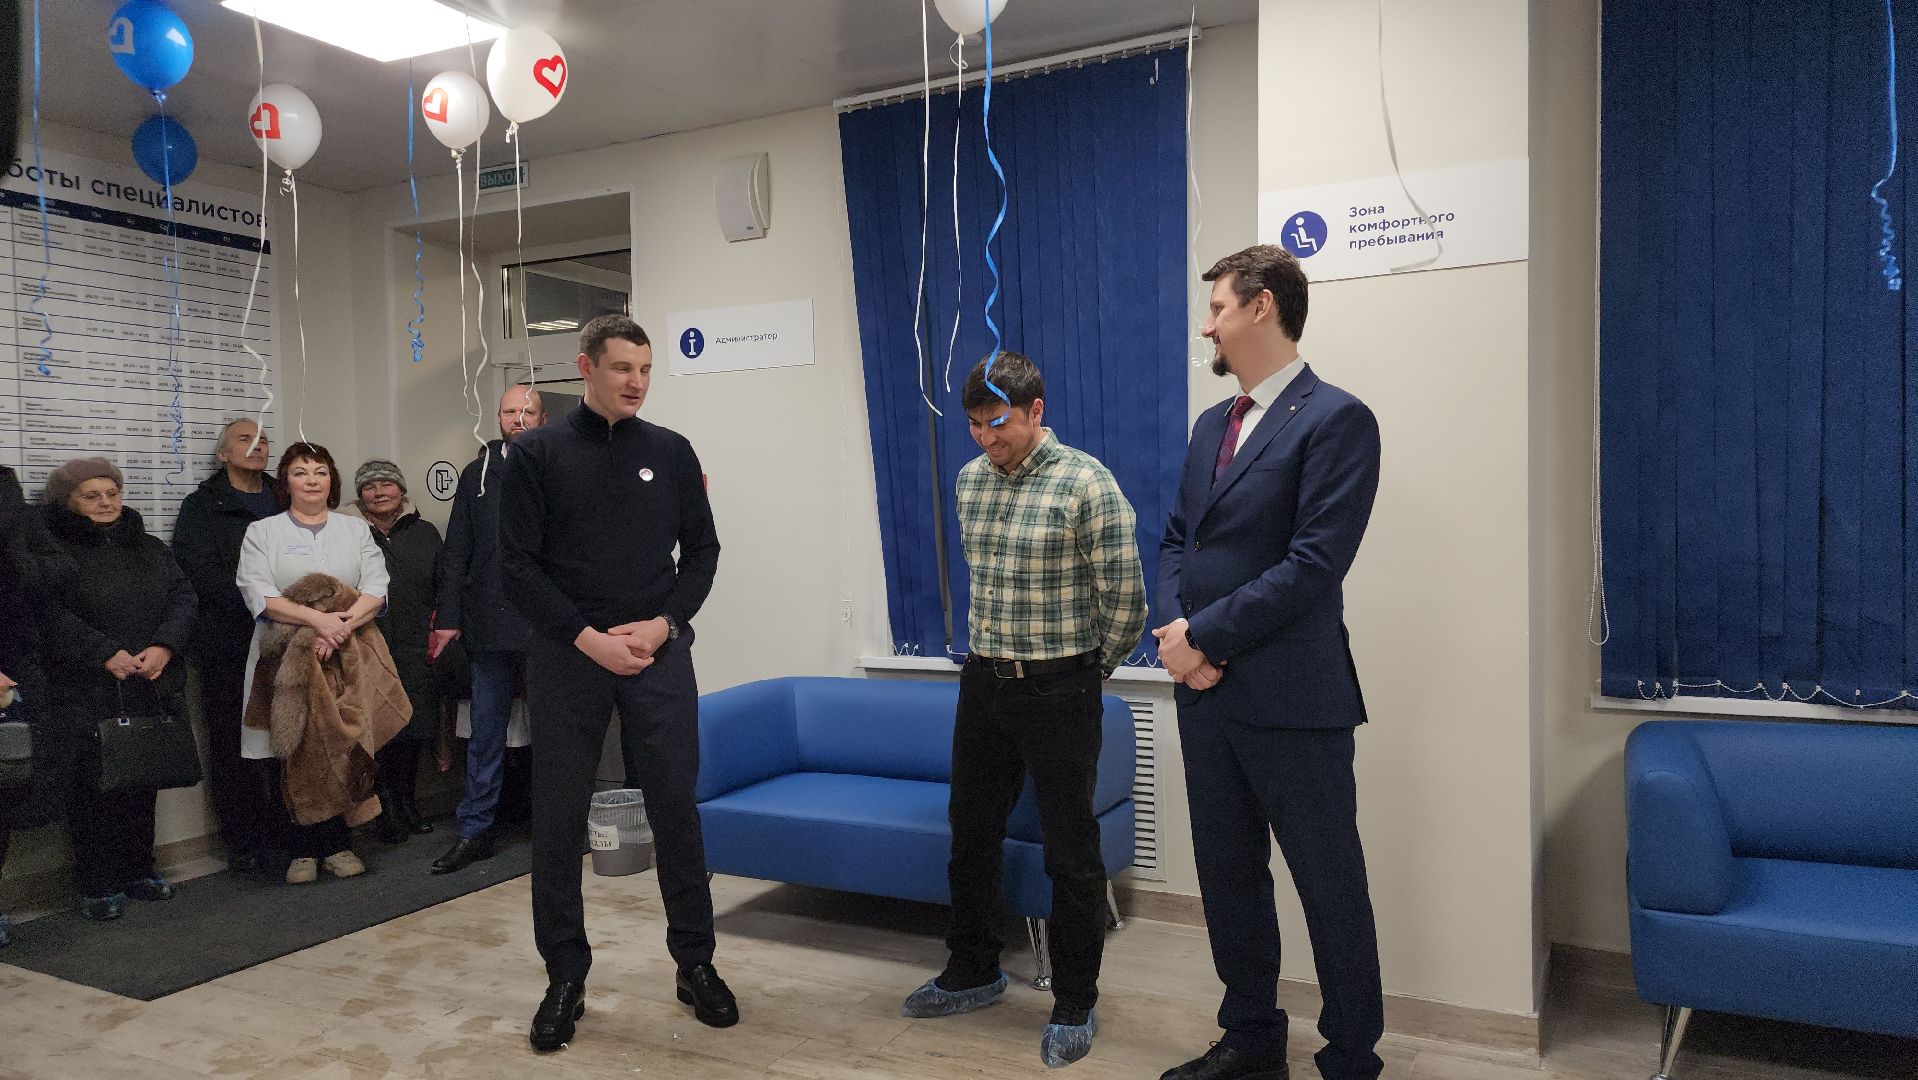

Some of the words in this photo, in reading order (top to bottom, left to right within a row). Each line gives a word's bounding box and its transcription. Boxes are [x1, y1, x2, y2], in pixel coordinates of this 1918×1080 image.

[91, 179, 268, 228] специалистов
[1349, 205, 1385, 217] Зона
[1349, 212, 1455, 233] комфортного
[1349, 230, 1444, 250] пребывания
[715, 332, 778, 344] Администратор
